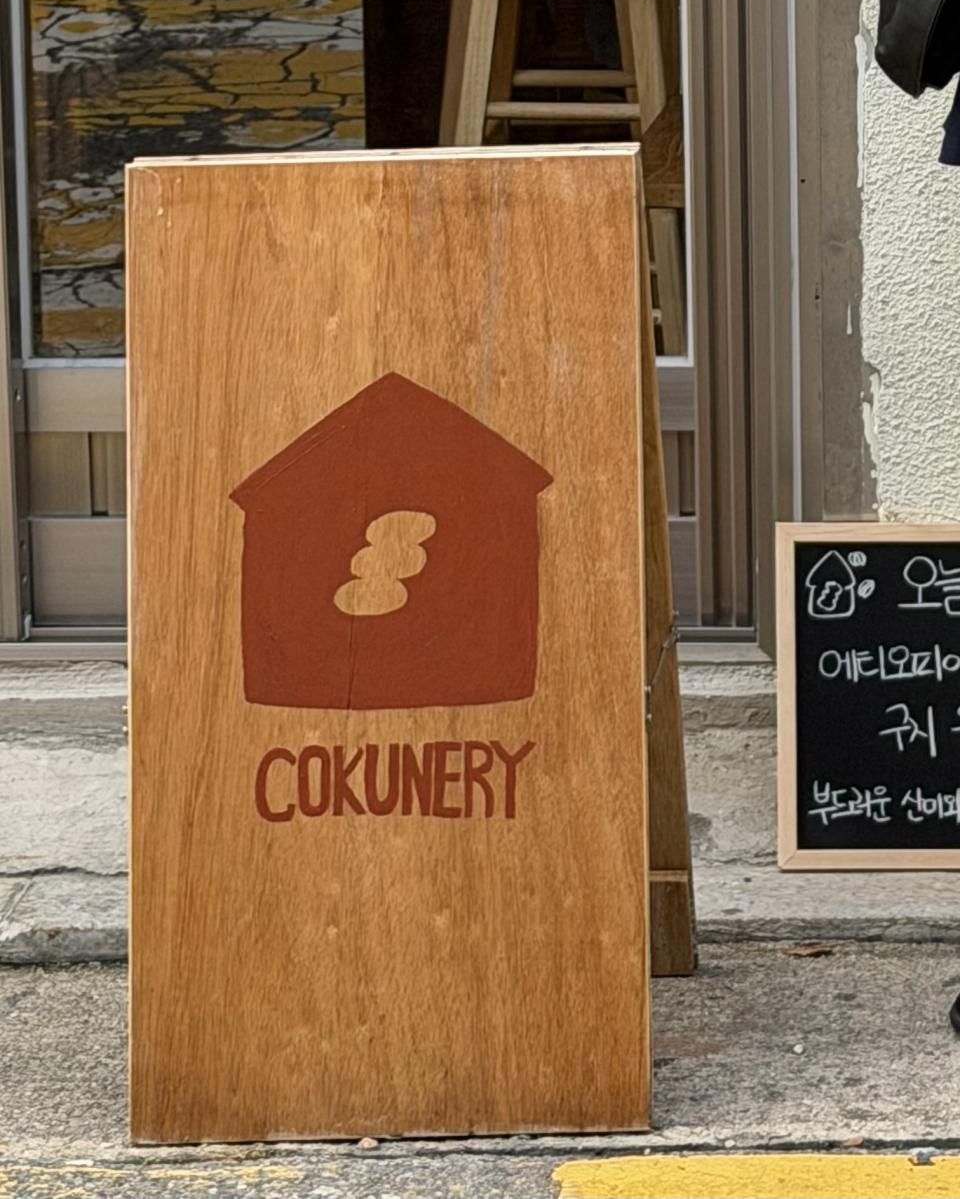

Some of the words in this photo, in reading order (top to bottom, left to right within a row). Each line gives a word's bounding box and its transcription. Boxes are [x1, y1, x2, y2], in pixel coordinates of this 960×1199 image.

[878, 702, 938, 758] 구지
[254, 739, 537, 823] COKUNERY
[807, 780, 892, 826] 부드러운
